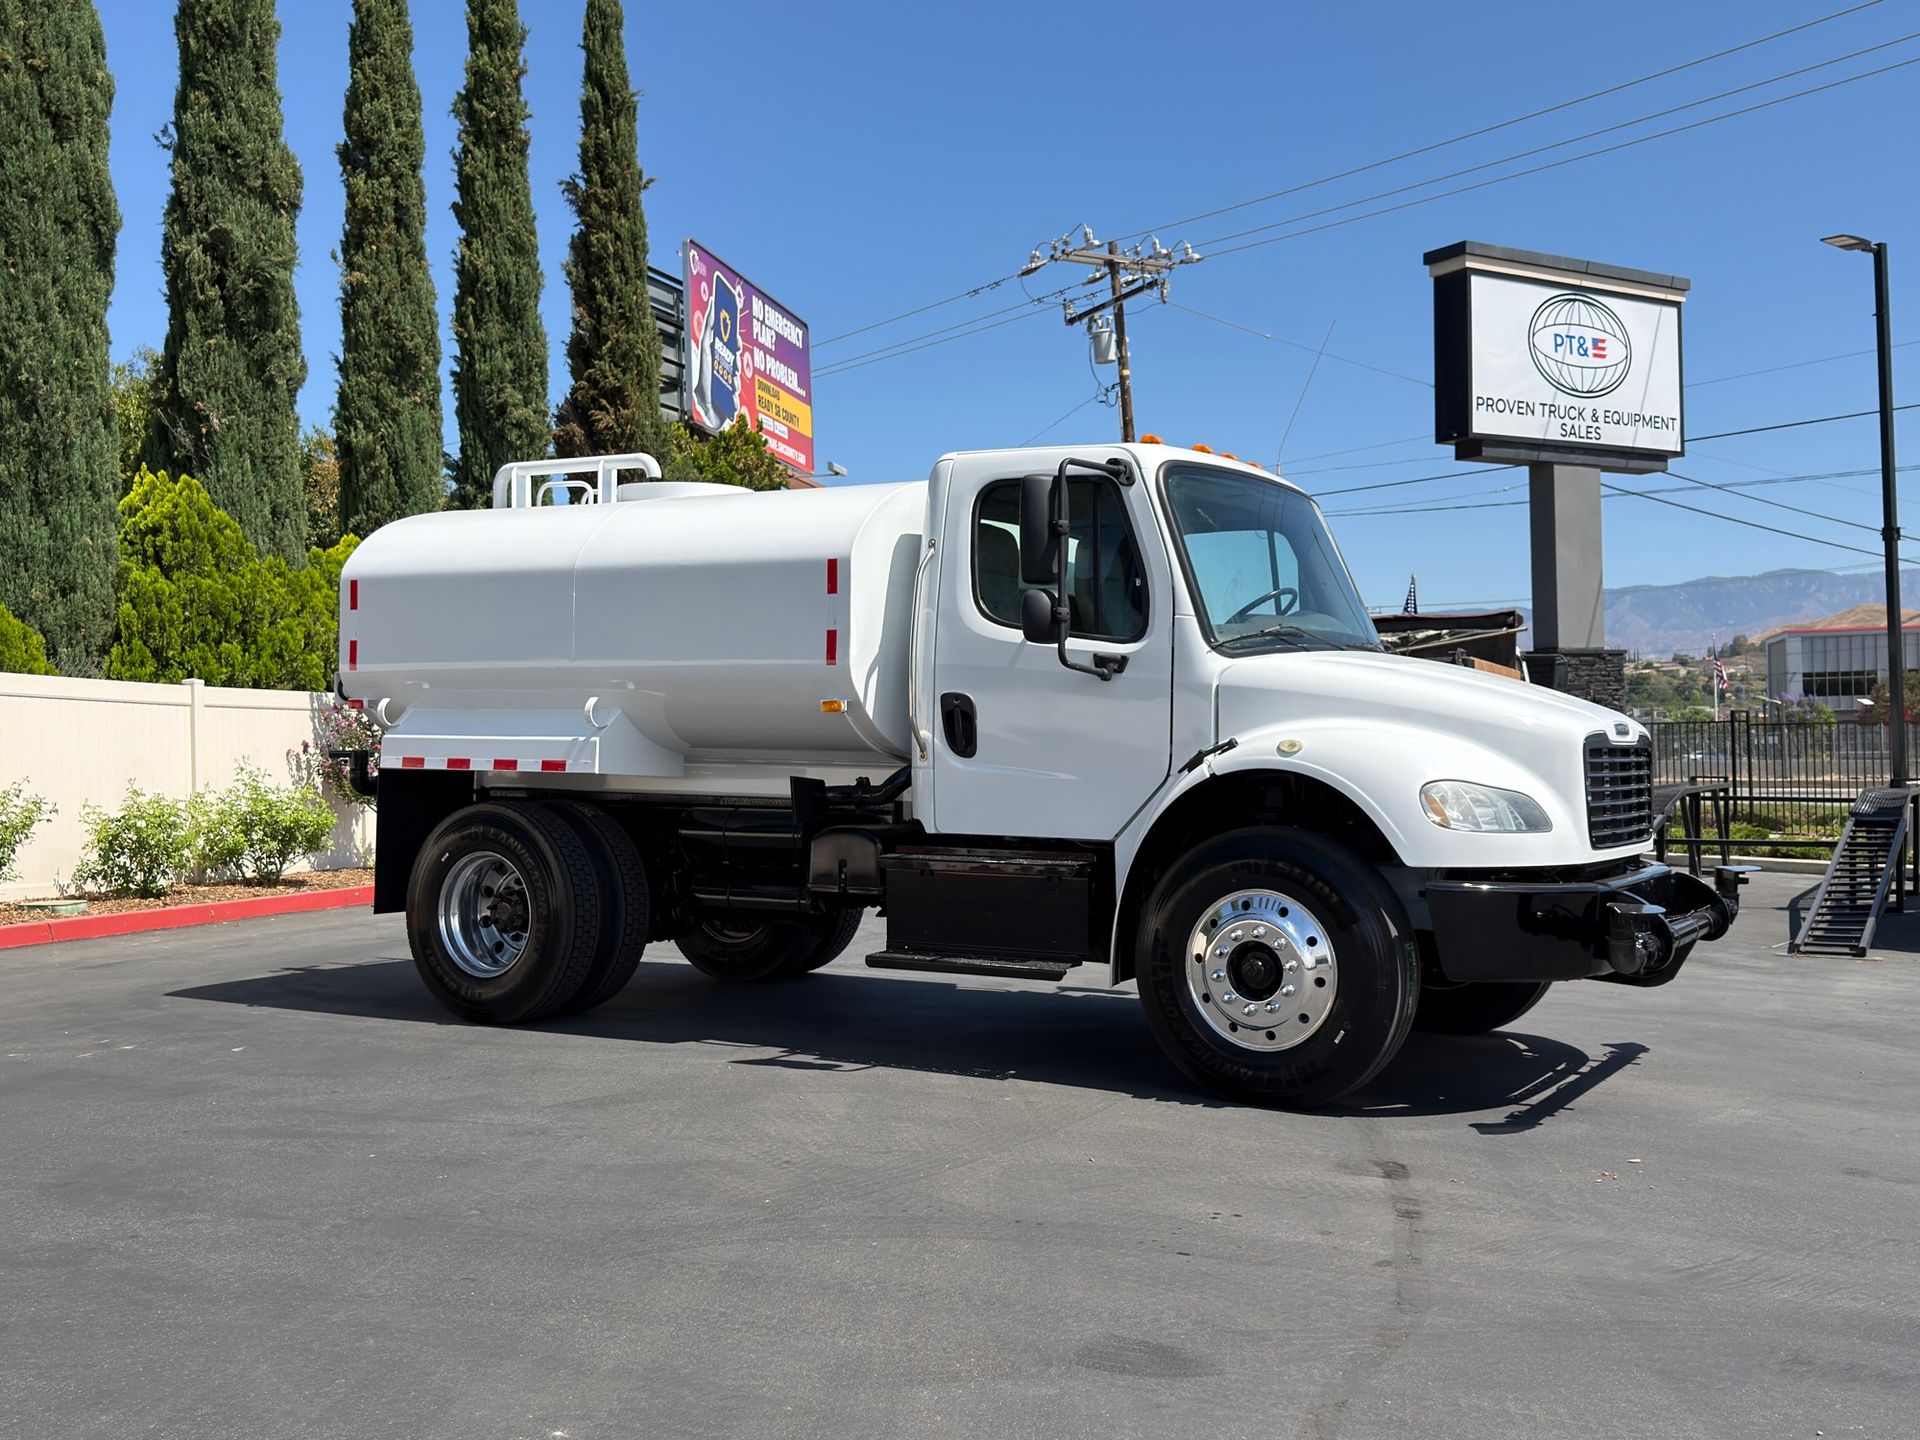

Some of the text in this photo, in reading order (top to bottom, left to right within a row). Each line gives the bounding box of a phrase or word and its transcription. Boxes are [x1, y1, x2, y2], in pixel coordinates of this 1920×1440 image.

[752, 295, 803, 349] NO EMERGENCY
[752, 318, 776, 351] PLAN?
[753, 346, 765, 372] NO
[1553, 333, 1607, 359] PT&E
[757, 379, 780, 401] DOWNLOAD
[758, 395, 774, 413] READY
[774, 403, 781, 418] SB
[782, 407, 800, 428] COUNTY
[1476, 396, 1677, 431] PROVEN TRUCK & EQUIPMENT
[1560, 422, 1601, 441] SALES
